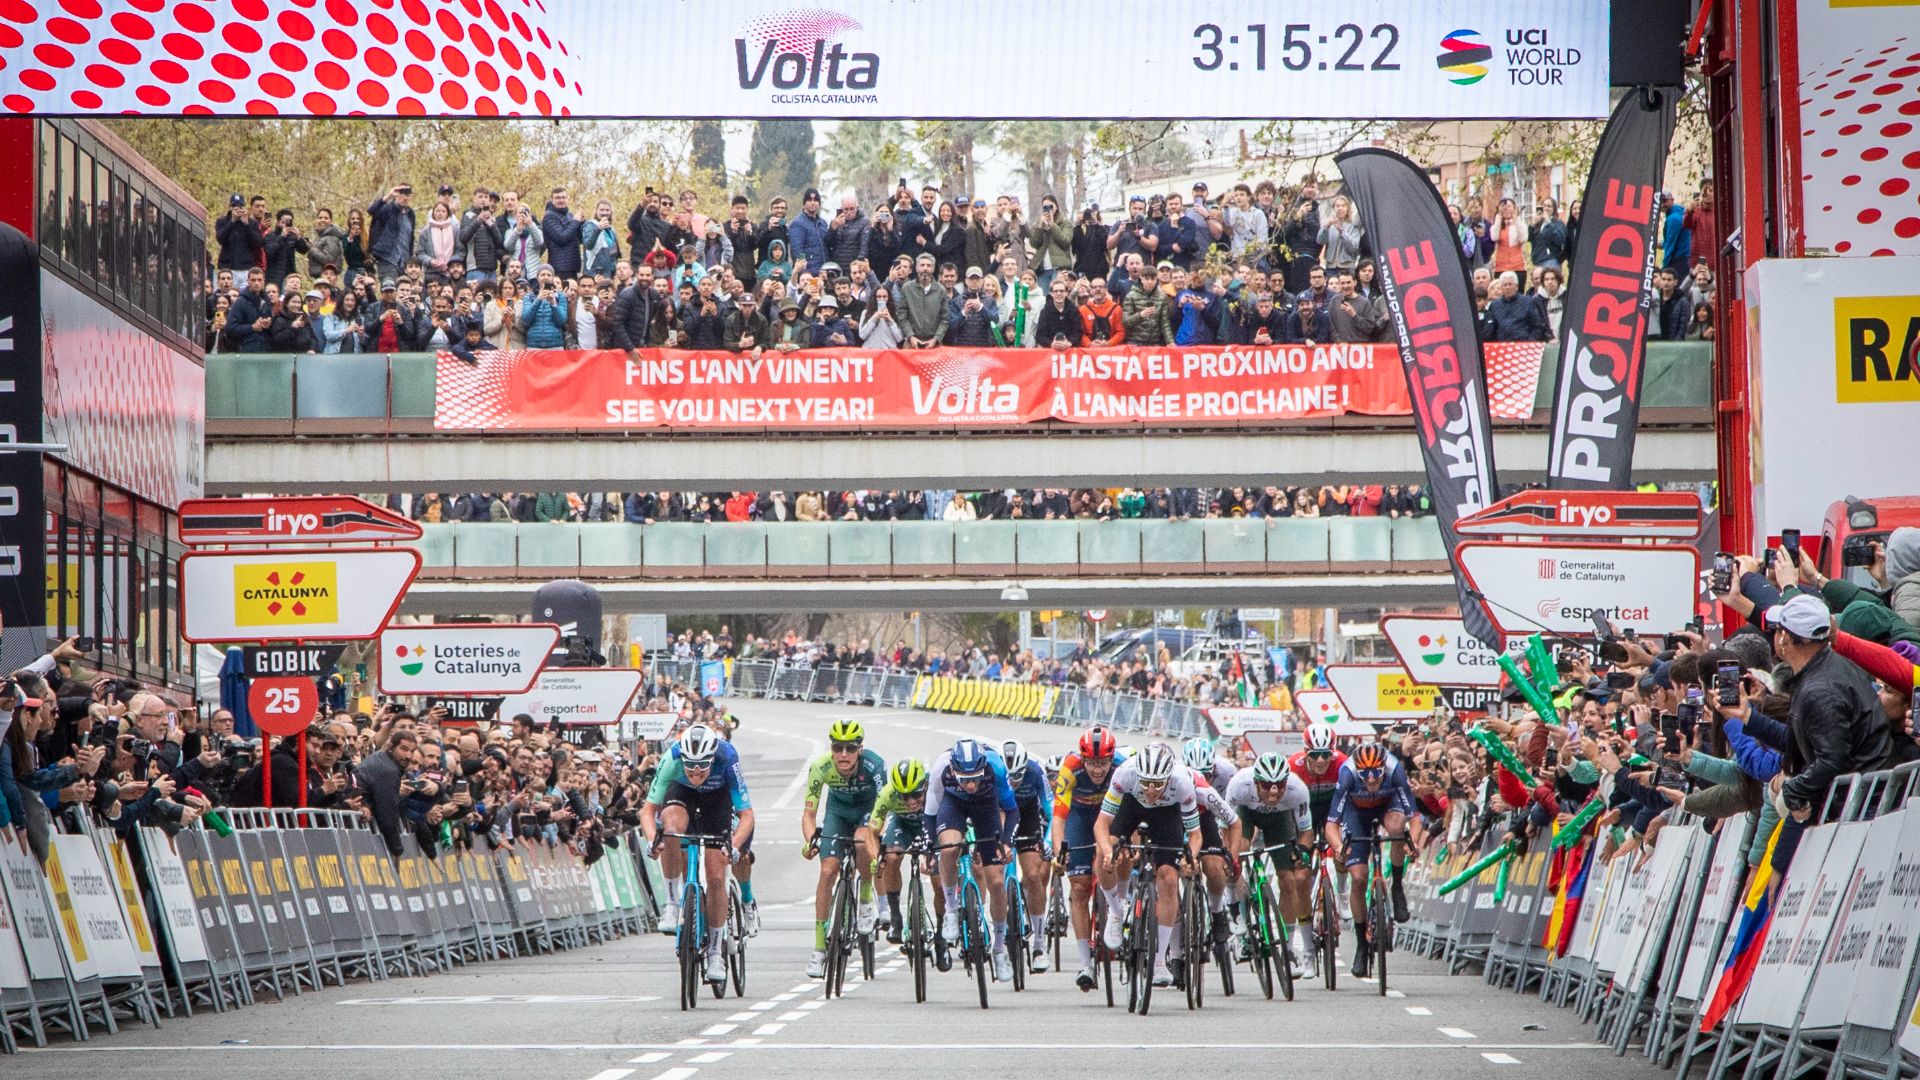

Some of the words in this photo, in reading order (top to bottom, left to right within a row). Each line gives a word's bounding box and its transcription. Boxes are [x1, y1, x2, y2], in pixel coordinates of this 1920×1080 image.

[1193, 23, 1400, 71] 3:15:22
[1505, 29, 1547, 46] UCI
[735, 38, 880, 89] Volta
[1506, 48, 1581, 66] WORLD
[1508, 68, 1563, 85] TOUR
[771, 94, 812, 104] CICLISTA
[821, 94, 878, 104] CATALUNYA
[1562, 178, 1655, 482] PRORIDE
[625, 359, 684, 386] FINS
[690, 359, 763, 385] L'ANY
[766, 358, 873, 384] VINENT!
[1051, 353, 1144, 381] ¡HASTA
[1147, 354, 1179, 380] EL
[1183, 345, 1307, 381] PRÓXIMO
[910, 375, 1020, 415] Volta
[1050, 386, 1069, 417] À
[1073, 388, 1181, 417] L'ANNÉE
[1186, 384, 1338, 418] PROCHAINE
[606, 400, 656, 424] SEE
[659, 399, 713, 423] YOU
[718, 399, 795, 423] NEXT
[795, 397, 874, 422] YEAR!
[267, 507, 318, 535] iryo
[1560, 499, 1611, 528] iryo
[1559, 571, 1573, 580] de
[1575, 571, 1626, 582] Catalunya
[1560, 561, 1615, 571] Generalitat
[243, 587, 329, 600] CATALUNYA
[255, 650, 321, 673] GOBIK
[434, 643, 505, 658] Loteries
[507, 649, 521, 658] de
[434, 660, 521, 677] Catalunya
[265, 687, 301, 714] 25
[1382, 688, 1436, 696] CATALUNYA
[543, 704, 597, 715] esportcat
